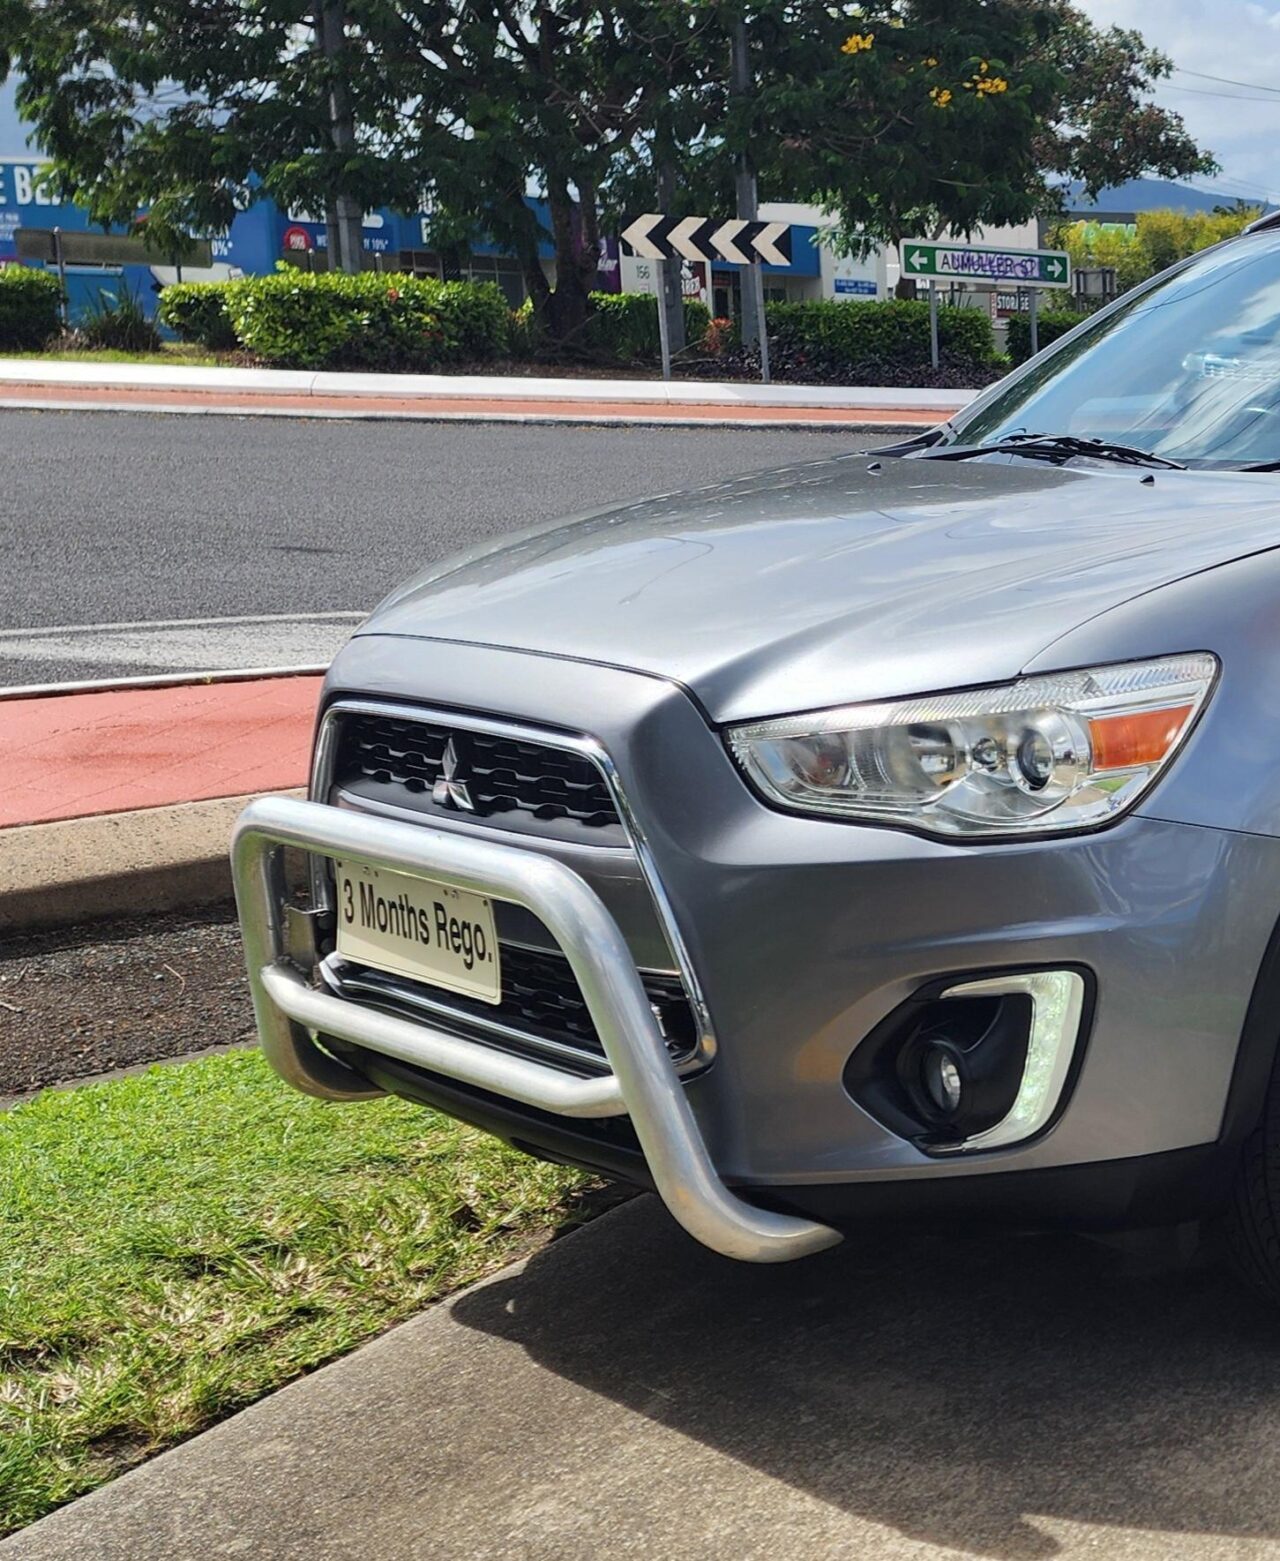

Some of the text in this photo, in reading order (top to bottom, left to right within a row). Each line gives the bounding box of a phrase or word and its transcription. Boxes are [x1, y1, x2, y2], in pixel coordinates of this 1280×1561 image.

[343, 878, 493, 970] 3 Months Rego.
